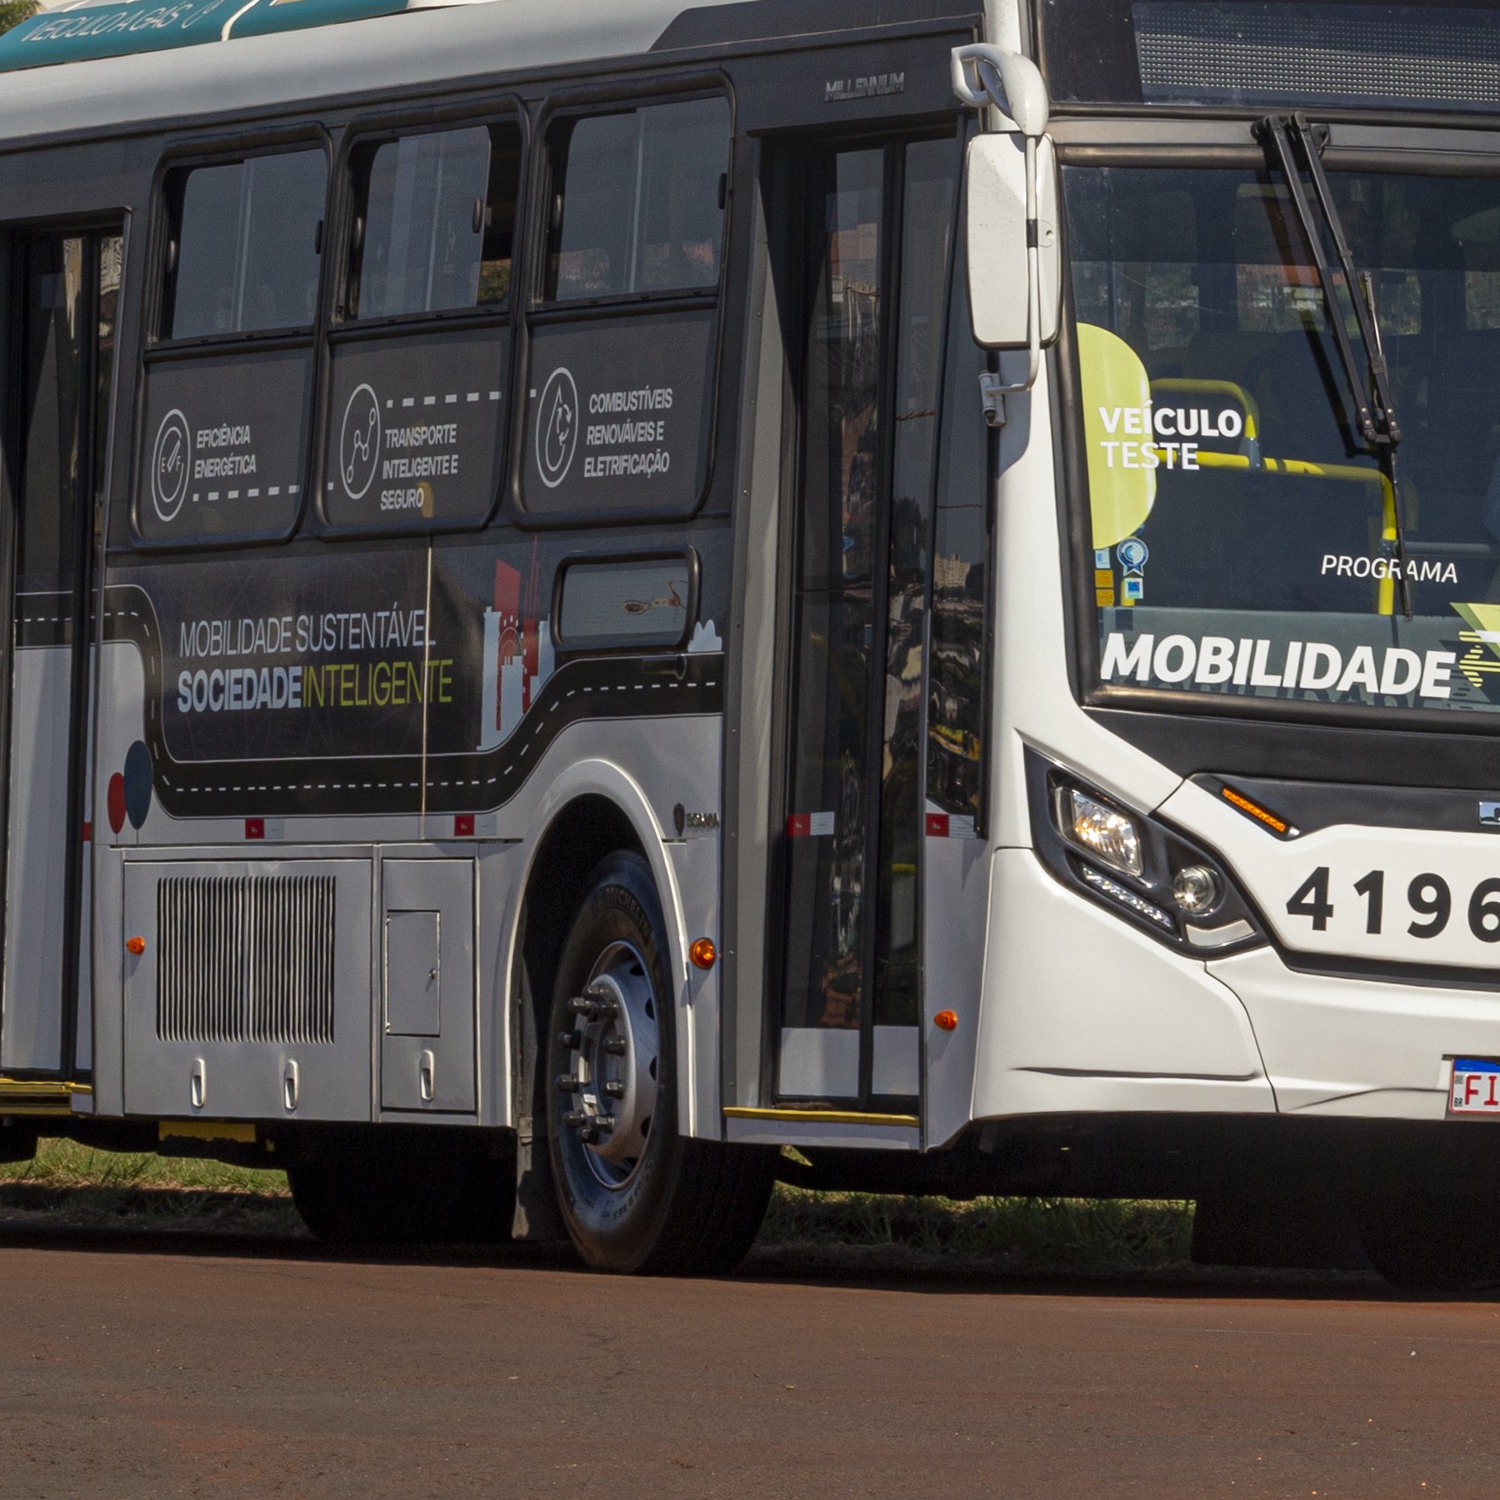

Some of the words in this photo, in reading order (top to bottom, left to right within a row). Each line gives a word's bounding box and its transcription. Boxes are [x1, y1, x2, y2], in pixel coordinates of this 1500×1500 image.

[589, 385, 673, 414] COMBUSTÍVEIS
[586, 418, 655, 446] RENOVÁVEIS
[656, 420, 665, 441] E
[1098, 400, 1243, 438] VEÍCULO
[196, 422, 251, 449] EFICIÊNCIA
[385, 424, 457, 449] TRANSPORTE
[194, 452, 257, 479] ENERGÉTICA
[382, 455, 449, 479] INTELIGENTE
[451, 454, 459, 474] E
[584, 448, 670, 479] ELETRIFICAÇÃO
[1100, 441, 1200, 470] TESTE
[380, 487, 424, 511] SEGURO
[1320, 554, 1458, 583] PROGRAMA
[179, 616, 293, 658] MOBILIDADE
[295, 601, 437, 652] SUSTENTÁVEL
[1100, 631, 1457, 699] MOBILIDADE
[177, 665, 302, 713] SOCIEDADE
[302, 658, 453, 708] INTELIGENTE
[1454, 1097, 1463, 1107] BR
